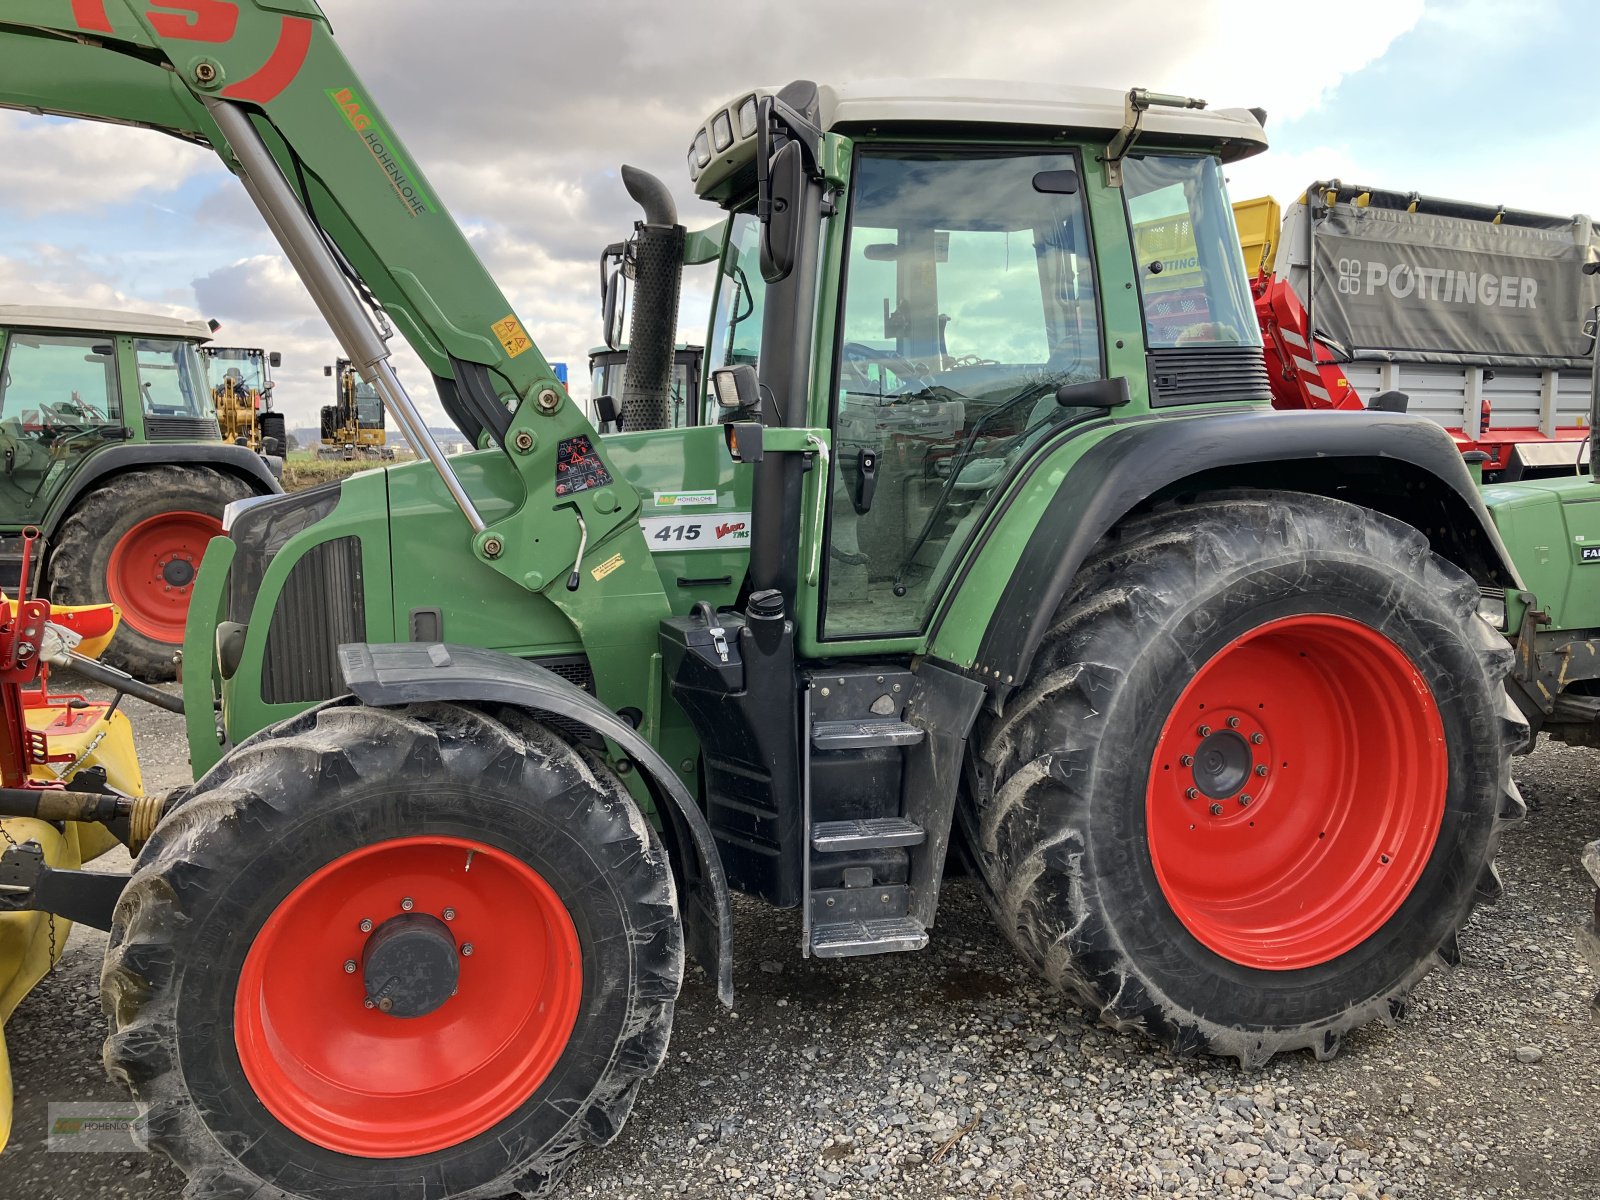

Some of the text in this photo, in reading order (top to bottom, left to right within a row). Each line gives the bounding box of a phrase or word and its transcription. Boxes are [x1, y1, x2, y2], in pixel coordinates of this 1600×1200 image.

[335, 88, 371, 131] BAG
[365, 133, 425, 215] HOHENLOHE
[654, 524, 702, 541] 415
[733, 530, 749, 539] TMS
[1583, 549, 1600, 558] FA
